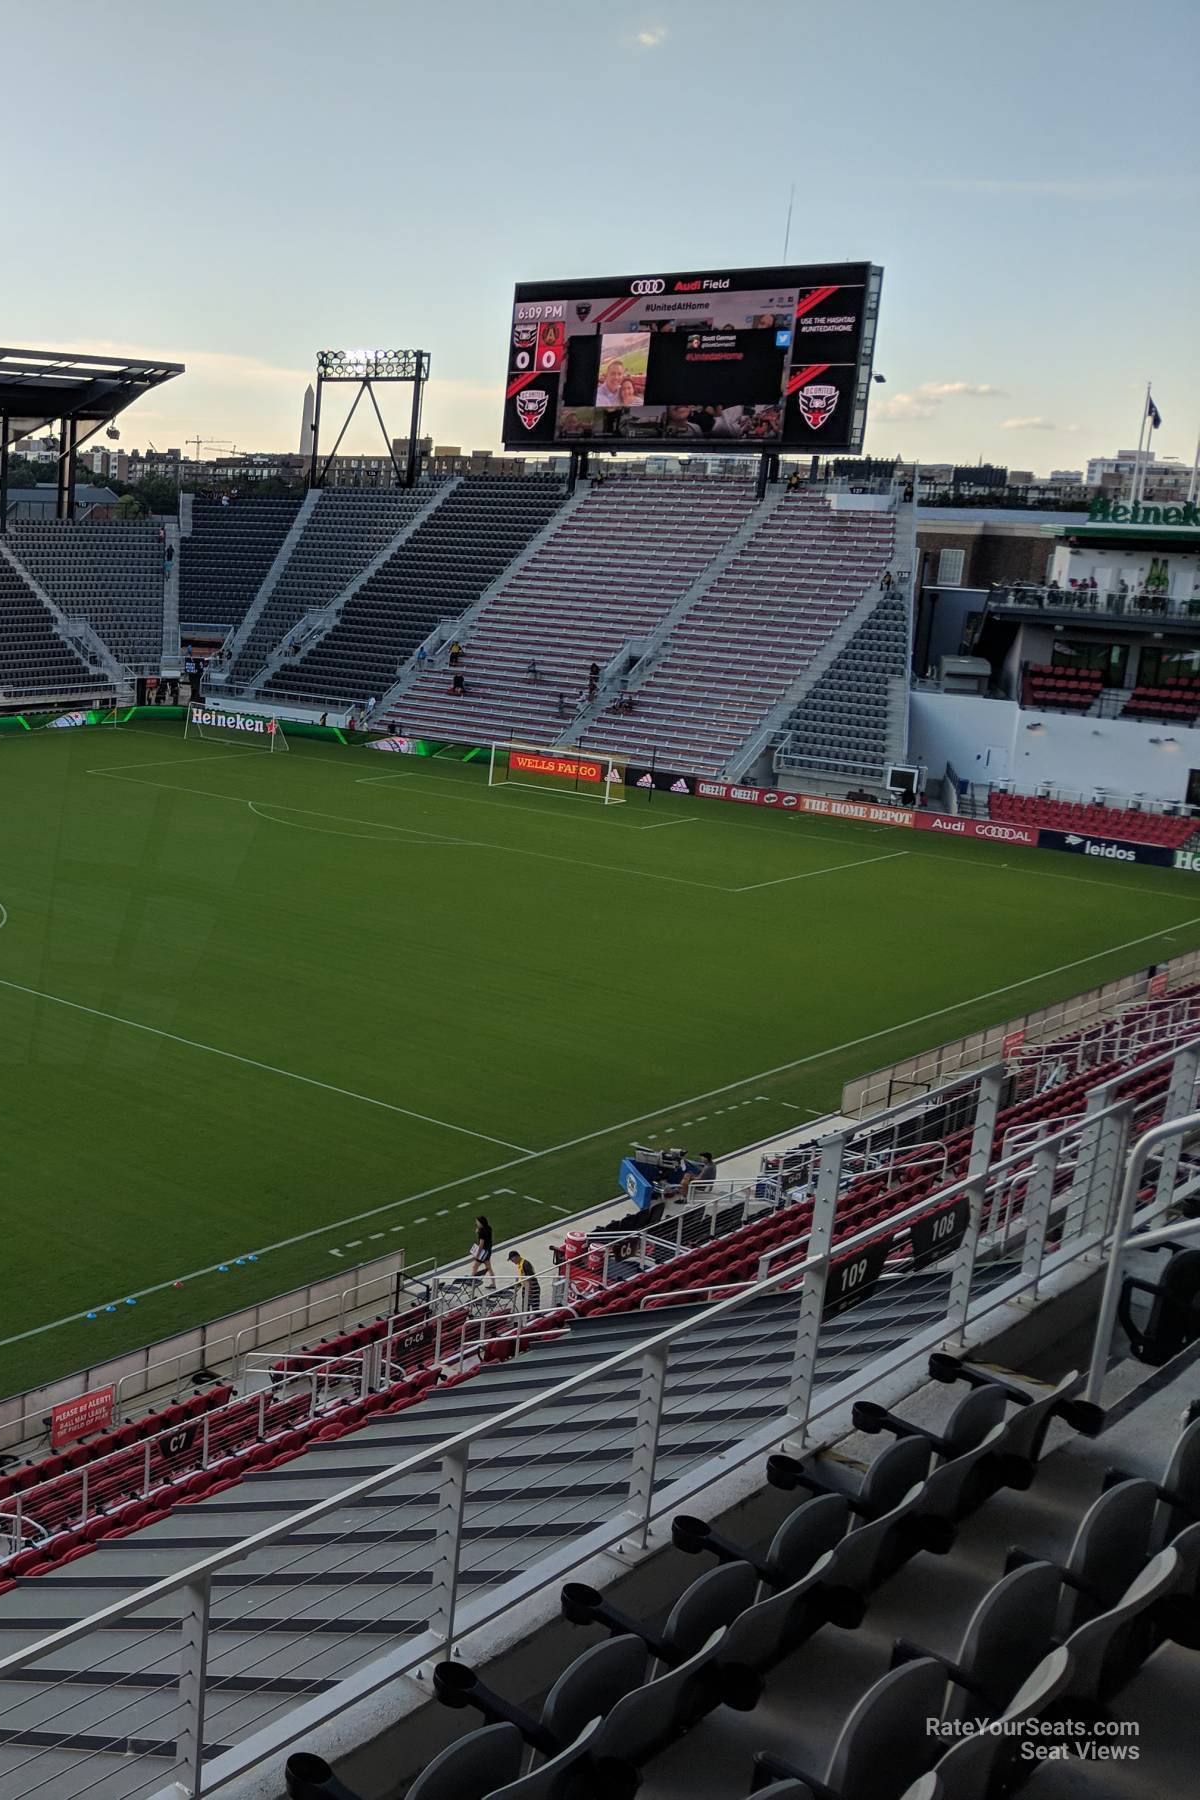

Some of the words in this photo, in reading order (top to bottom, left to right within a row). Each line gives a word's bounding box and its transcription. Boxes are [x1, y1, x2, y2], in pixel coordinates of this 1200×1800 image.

[674, 280, 700, 291] Audi
[702, 278, 730, 290] Field
[518, 306, 542, 320] 6:09
[544, 305, 563, 318] PM
[645, 302, 710, 312] #UnitedAtHome
[814, 316, 826, 324] THE
[516, 352, 530, 369] 0
[542, 350, 556, 369] 0
[191, 707, 265, 733] Heineken
[517, 757, 556, 771] WELLS
[803, 798, 828, 812] THE
[831, 803, 867, 818] HOME
[869, 808, 913, 825] DEPOT
[931, 818, 965, 832] Audi
[1084, 840, 1136, 861] leidos
[932, 1212, 955, 1242] 108
[620, 1241, 632, 1257] C6
[841, 1258, 867, 1291] 109
[55, 1406, 79, 1423] PLEASE
[79, 1403, 88, 1413] BE
[88, 1394, 111, 1410] ALERT!
[74, 1414, 87, 1424] MAY
[169, 1432, 187, 1452] C7
